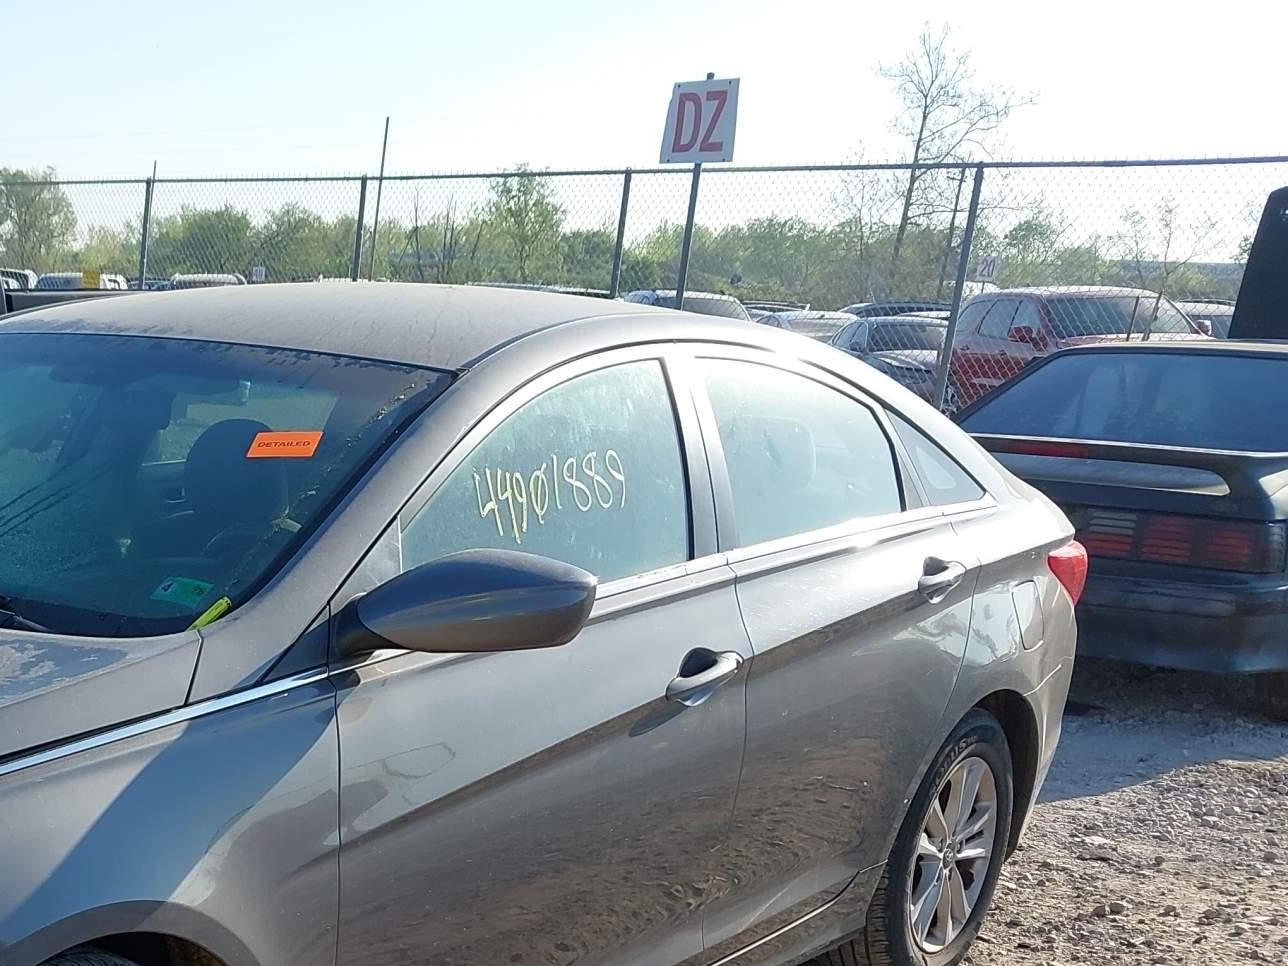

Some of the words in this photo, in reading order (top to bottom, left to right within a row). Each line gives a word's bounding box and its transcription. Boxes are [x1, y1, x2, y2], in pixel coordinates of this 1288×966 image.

[672, 89, 728, 153] DZ
[257, 440, 312, 448] DETAILED
[473, 450, 626, 544] 44901889
